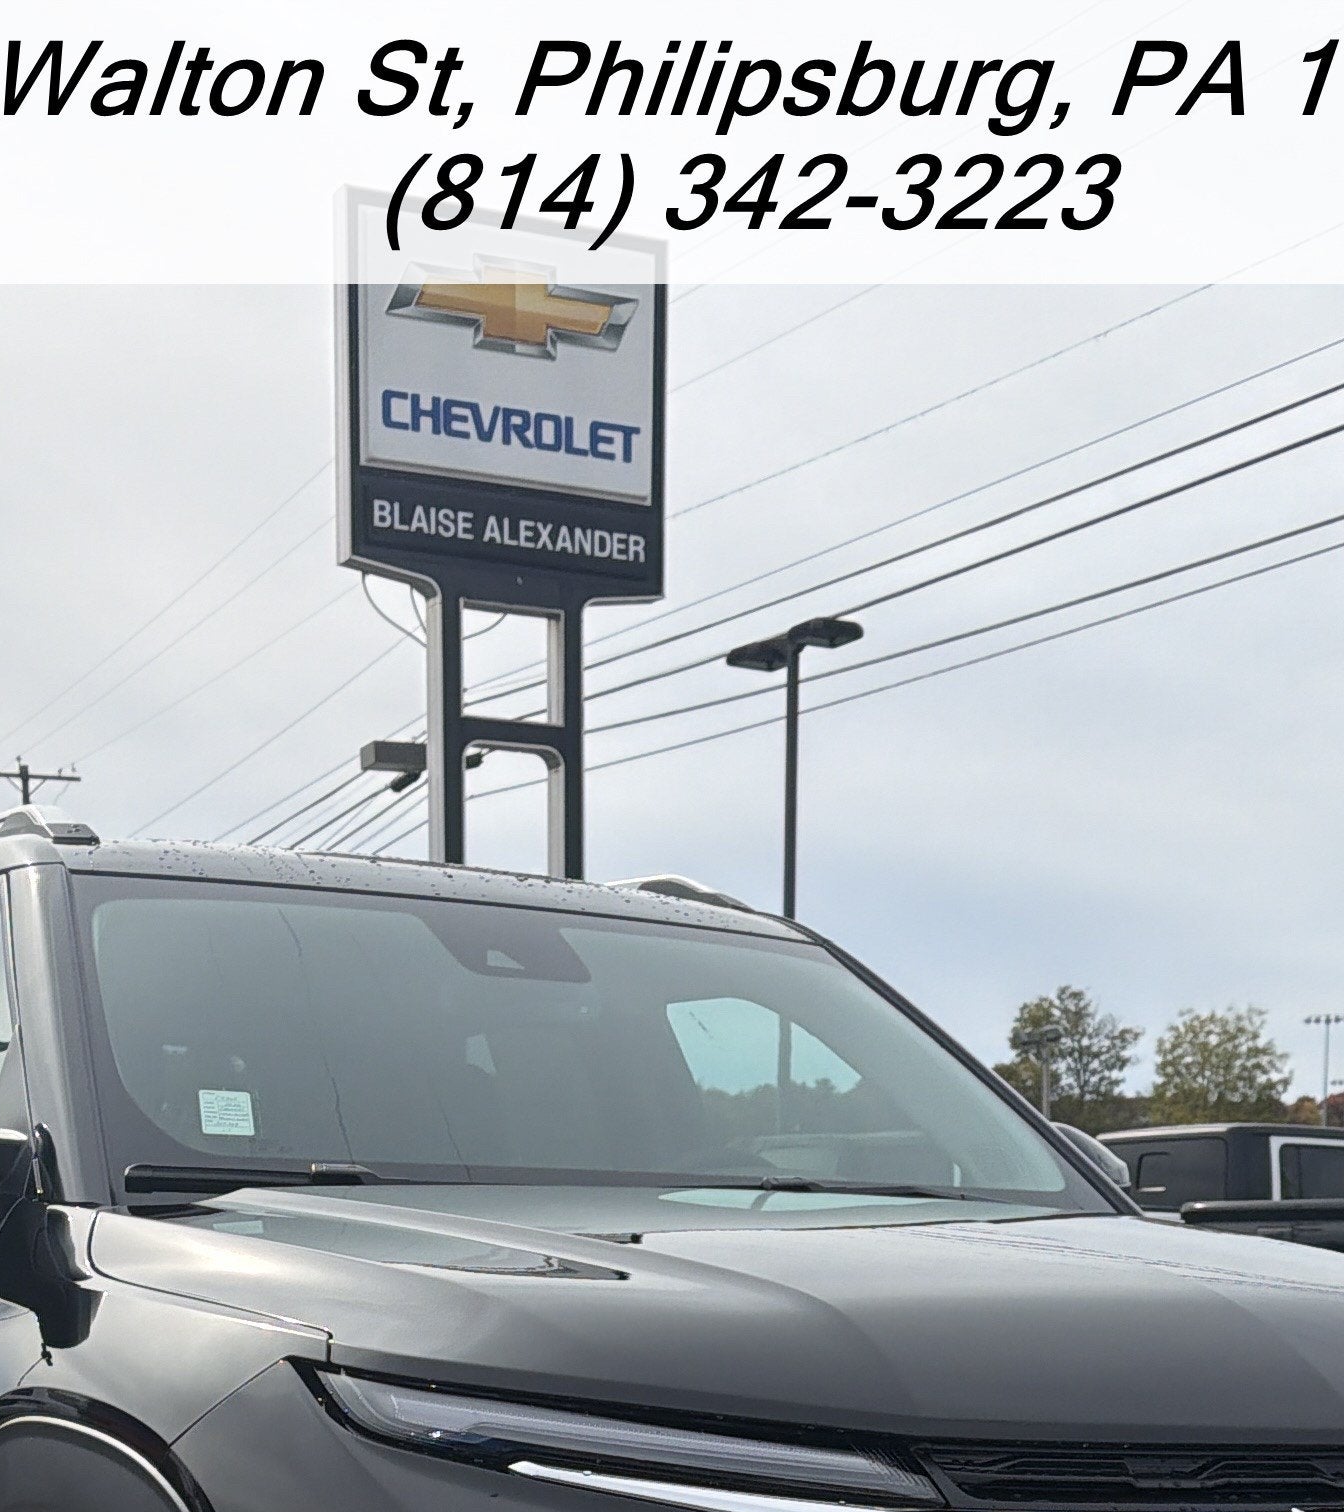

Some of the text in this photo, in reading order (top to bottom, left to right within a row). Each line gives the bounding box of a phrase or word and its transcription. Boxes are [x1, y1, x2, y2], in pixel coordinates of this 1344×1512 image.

[381, 389, 641, 463] CHEVROLET
[372, 498, 646, 563] BLAISE ALEXANDER
